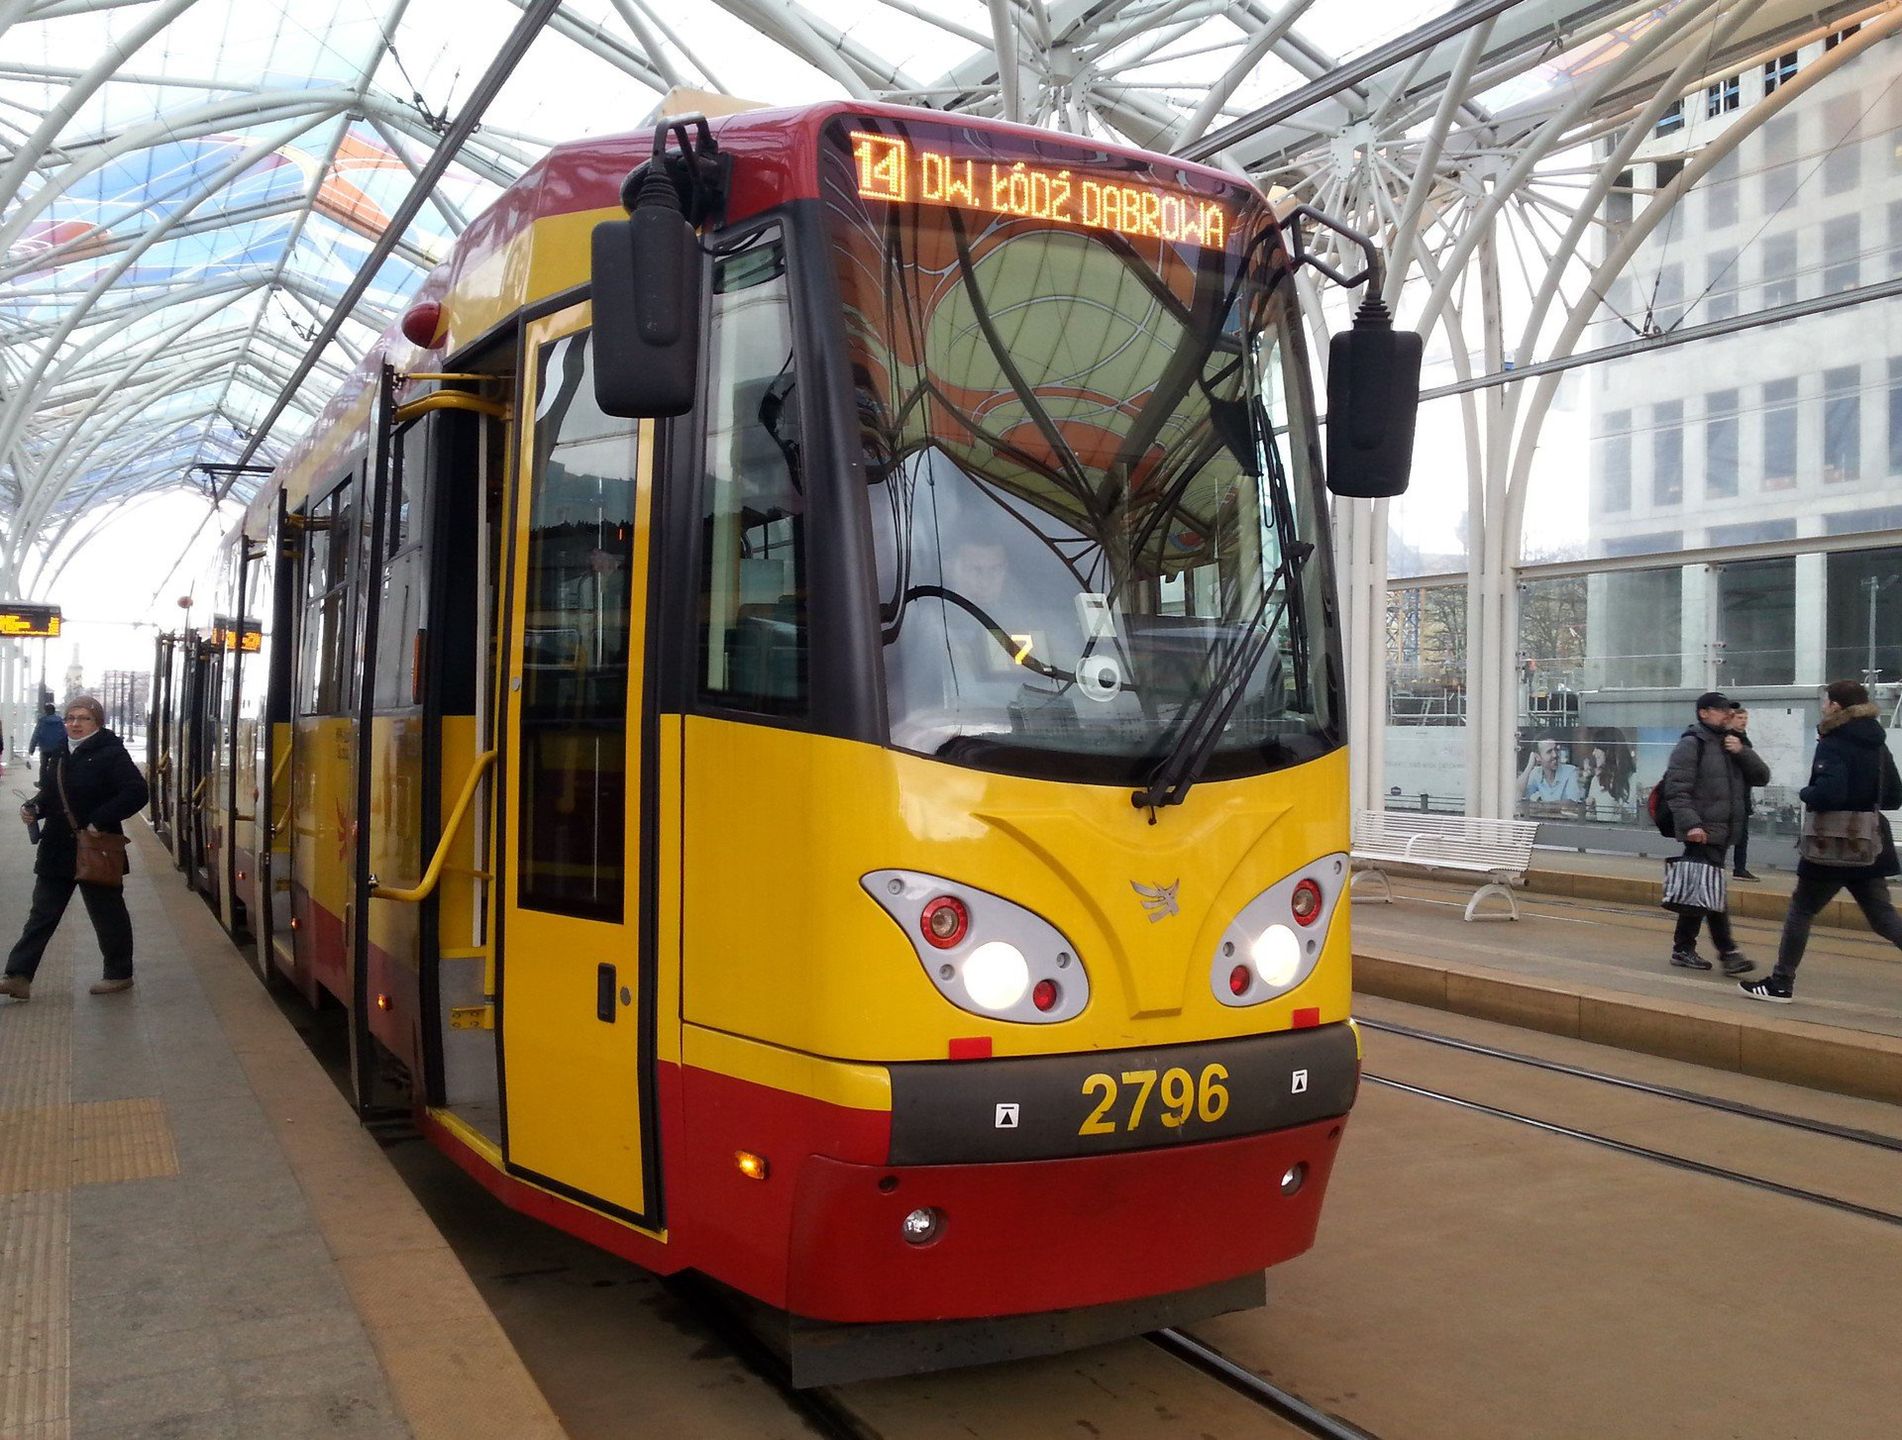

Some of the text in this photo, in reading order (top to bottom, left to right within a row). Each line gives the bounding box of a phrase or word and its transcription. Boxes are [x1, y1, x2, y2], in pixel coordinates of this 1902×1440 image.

[854, 141, 898, 193] 14
[922, 151, 980, 207] DW.
[991, 161, 1071, 223] ŁÓDŹ
[1078, 1063, 1230, 1136] 2796
